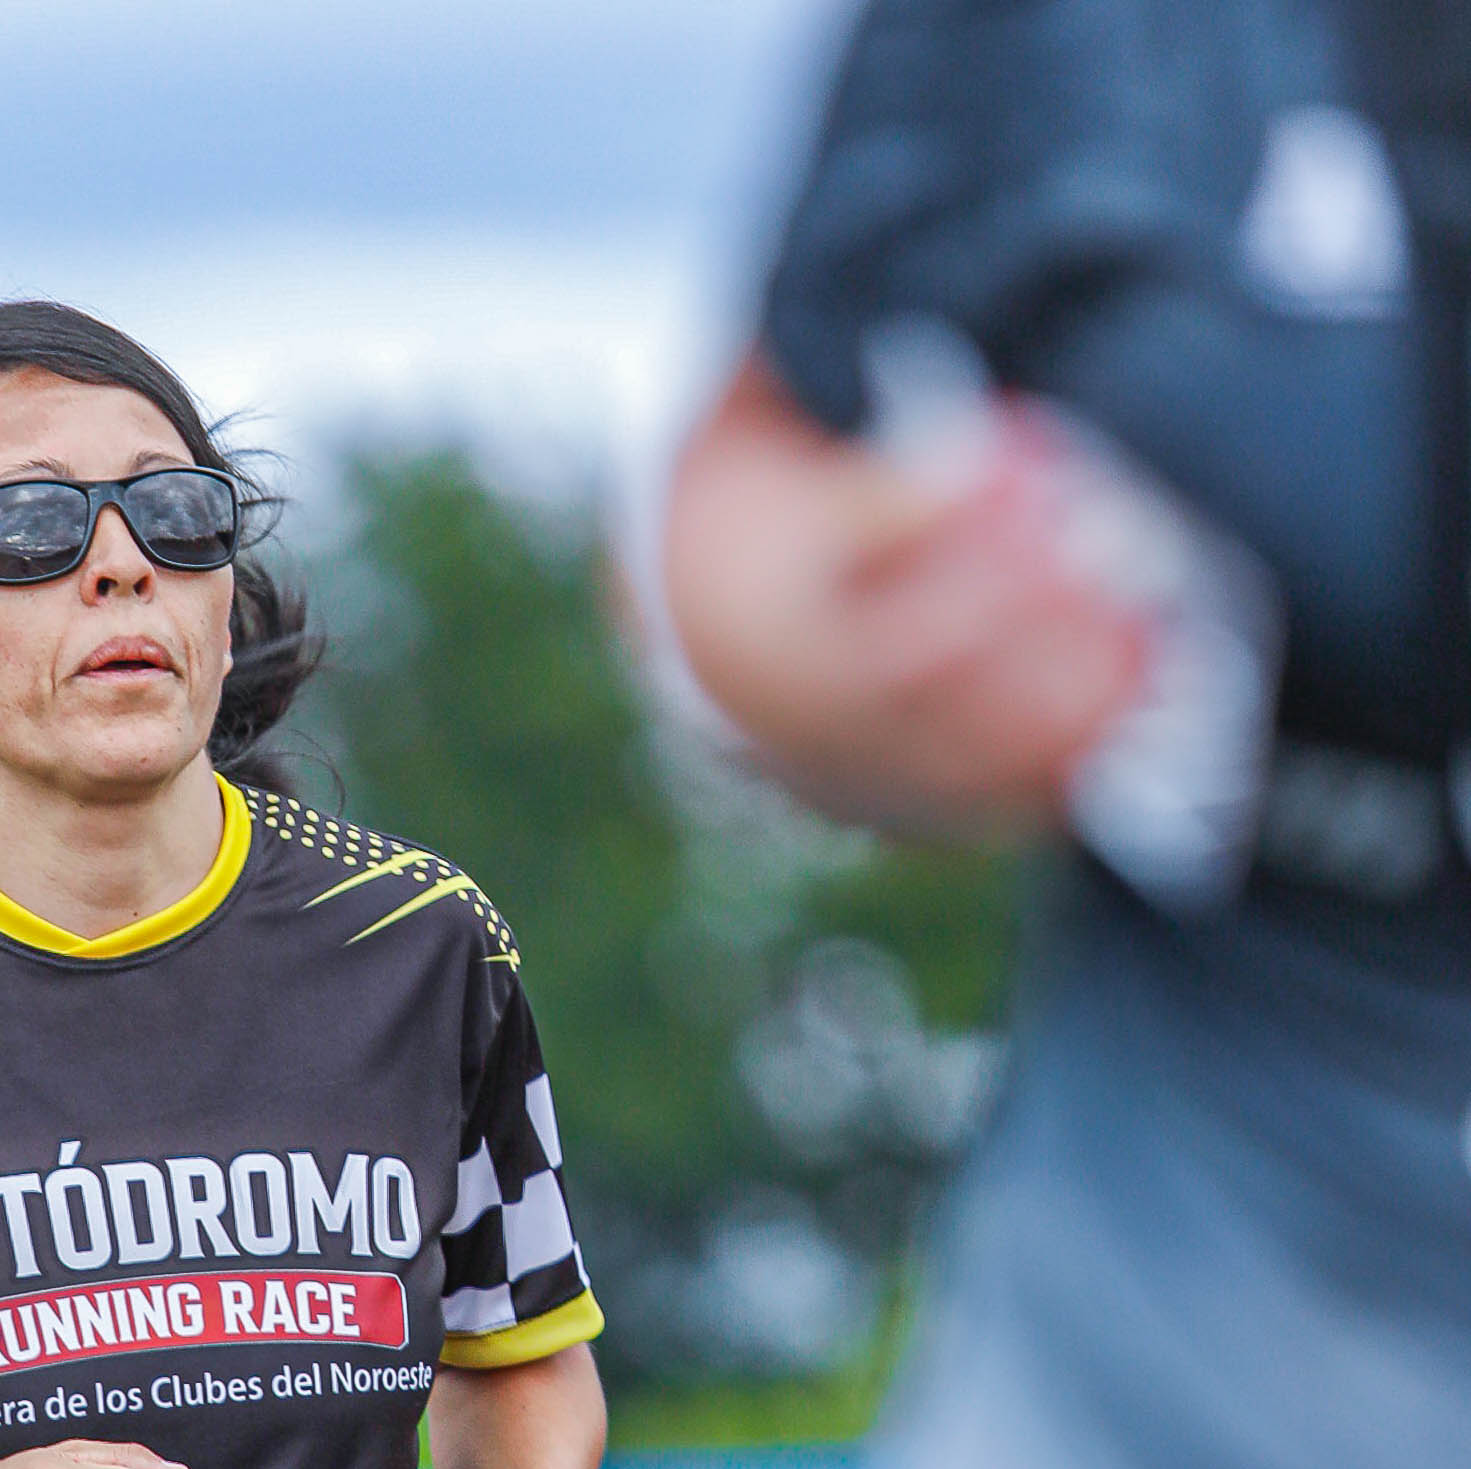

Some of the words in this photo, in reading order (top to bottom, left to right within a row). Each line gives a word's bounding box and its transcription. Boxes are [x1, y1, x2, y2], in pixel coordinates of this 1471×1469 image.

[218, 1279, 362, 1338] RACE
[44, 1386, 89, 1420] de
[95, 1381, 144, 1415] los
[150, 1371, 265, 1409] Clubes
[271, 1362, 324, 1398] del
[329, 1360, 433, 1395] Noroeste
